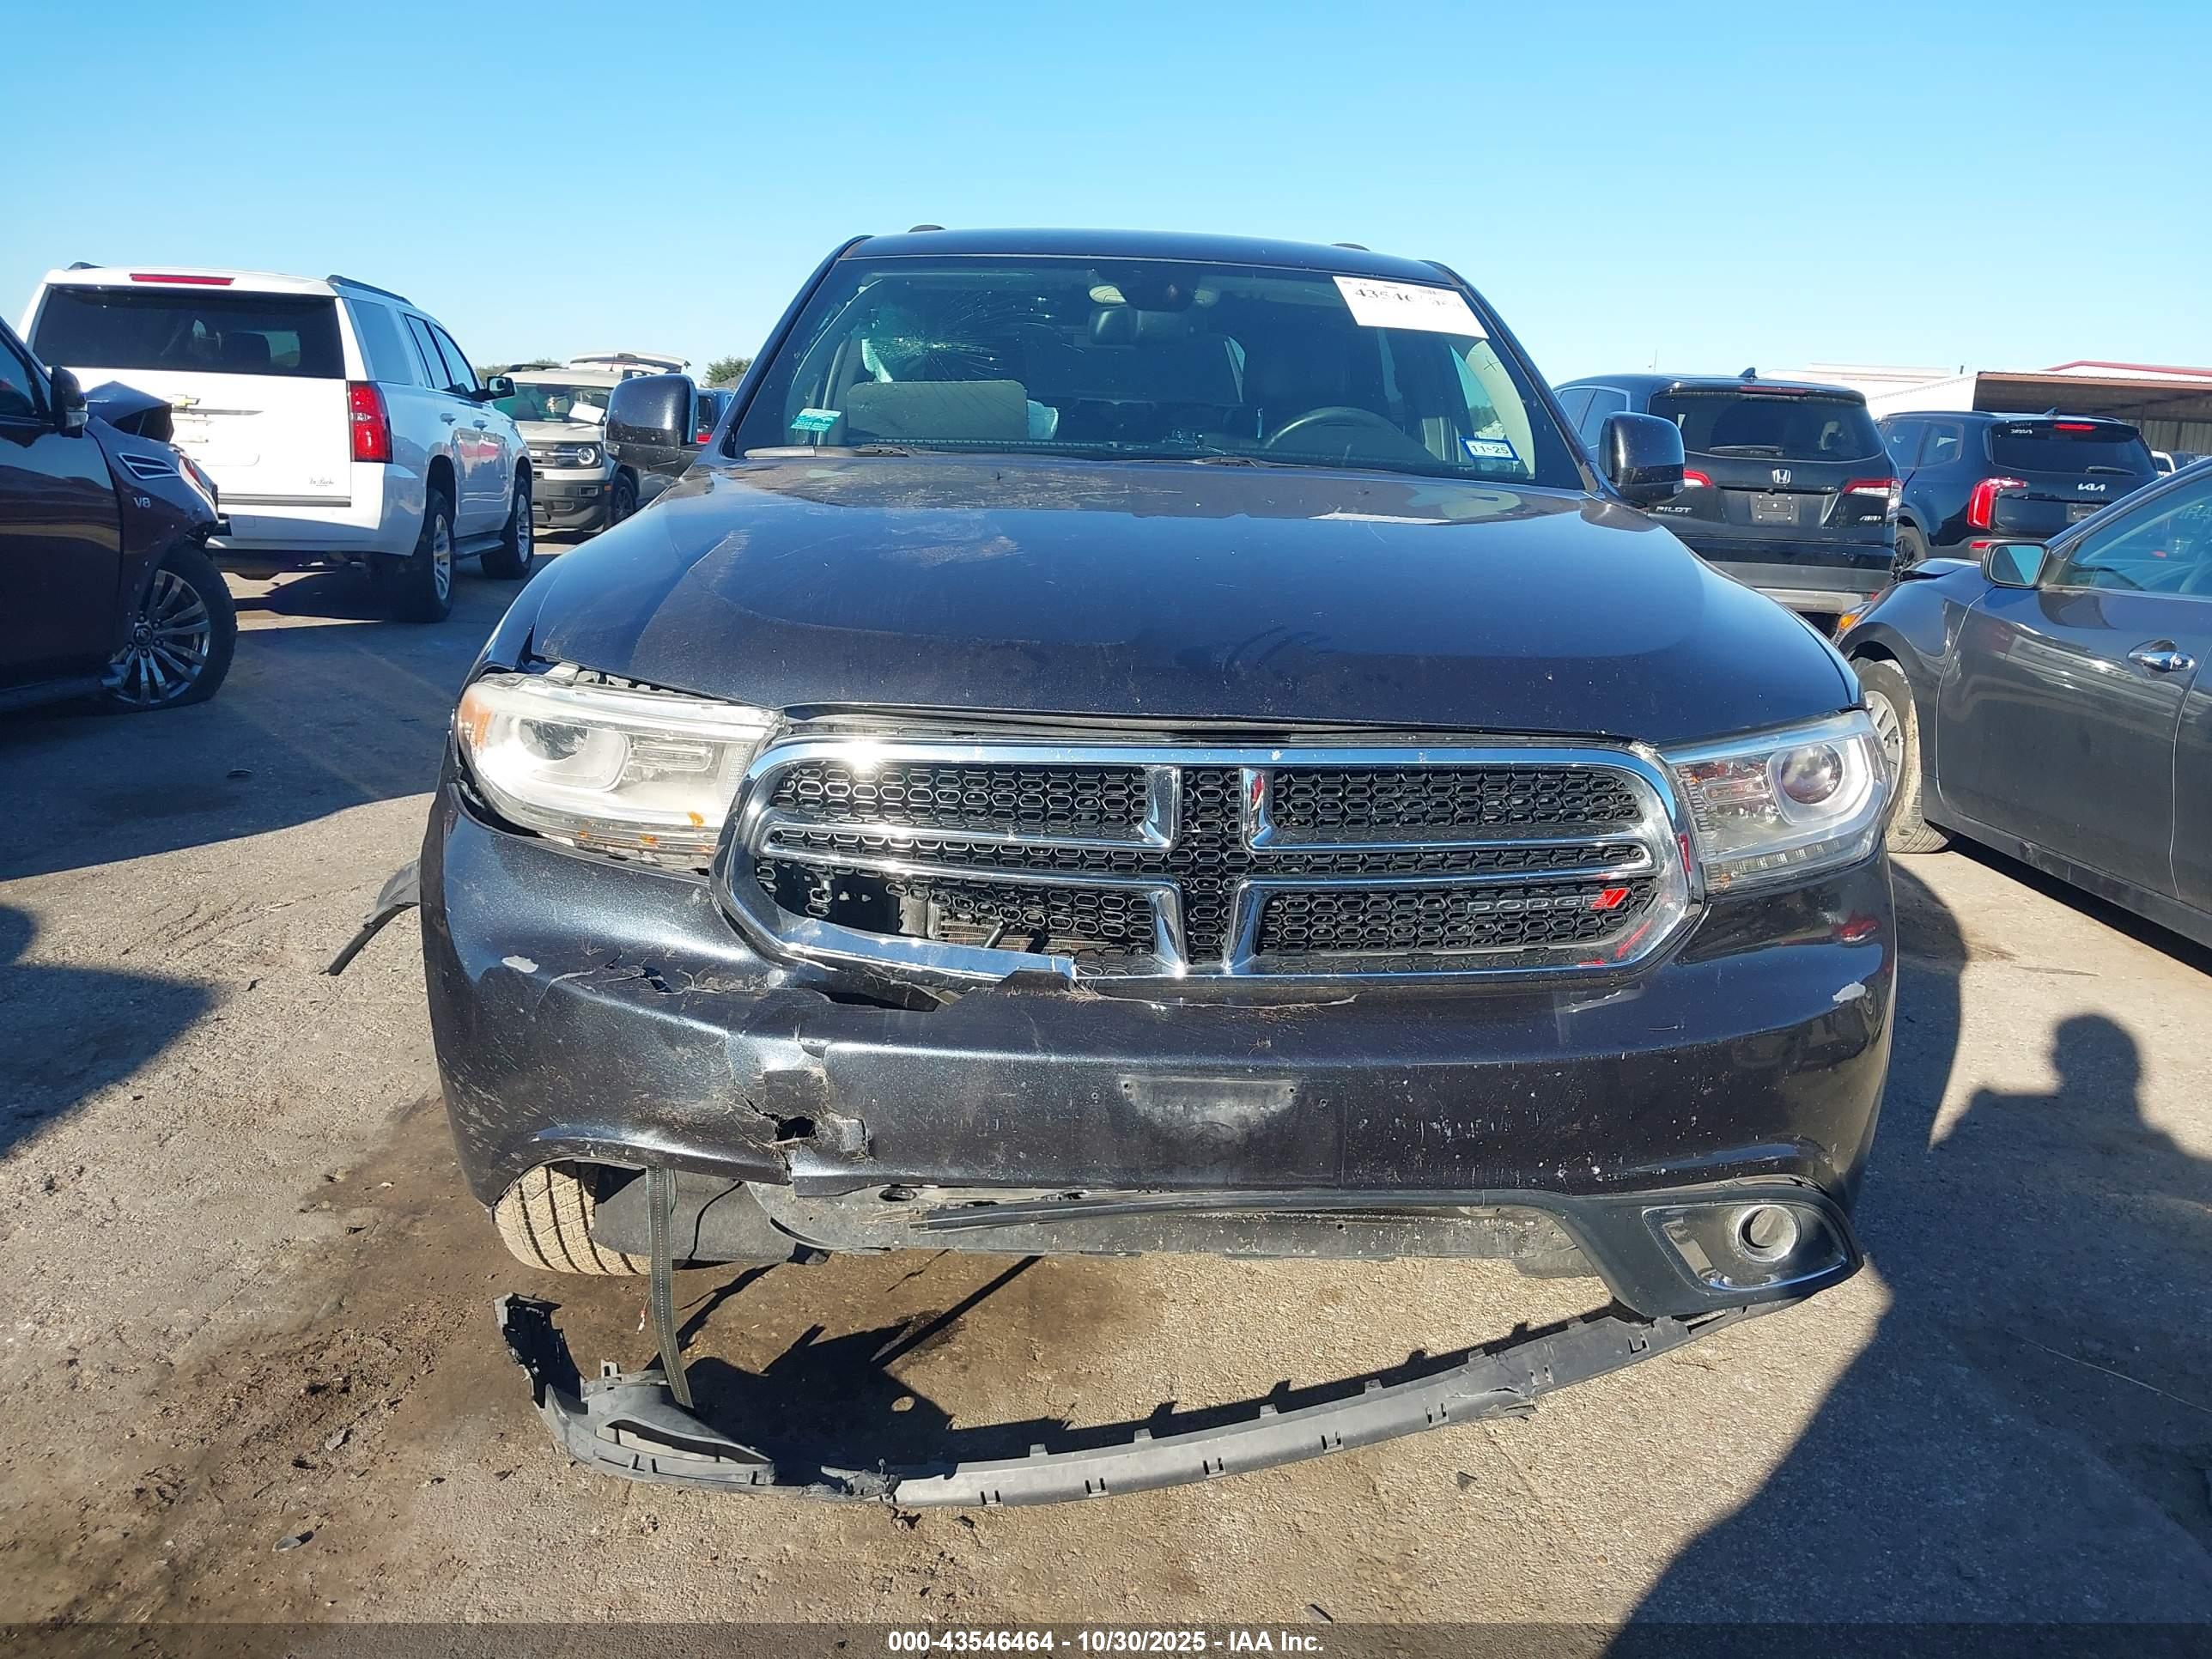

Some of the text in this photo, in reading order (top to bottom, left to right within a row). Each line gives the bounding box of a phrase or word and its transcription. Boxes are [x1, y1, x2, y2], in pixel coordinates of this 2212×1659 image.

[2077, 483, 2106, 492] KIA
[132, 496, 152, 508] V8
[1467, 894, 1601, 914] DODGE
